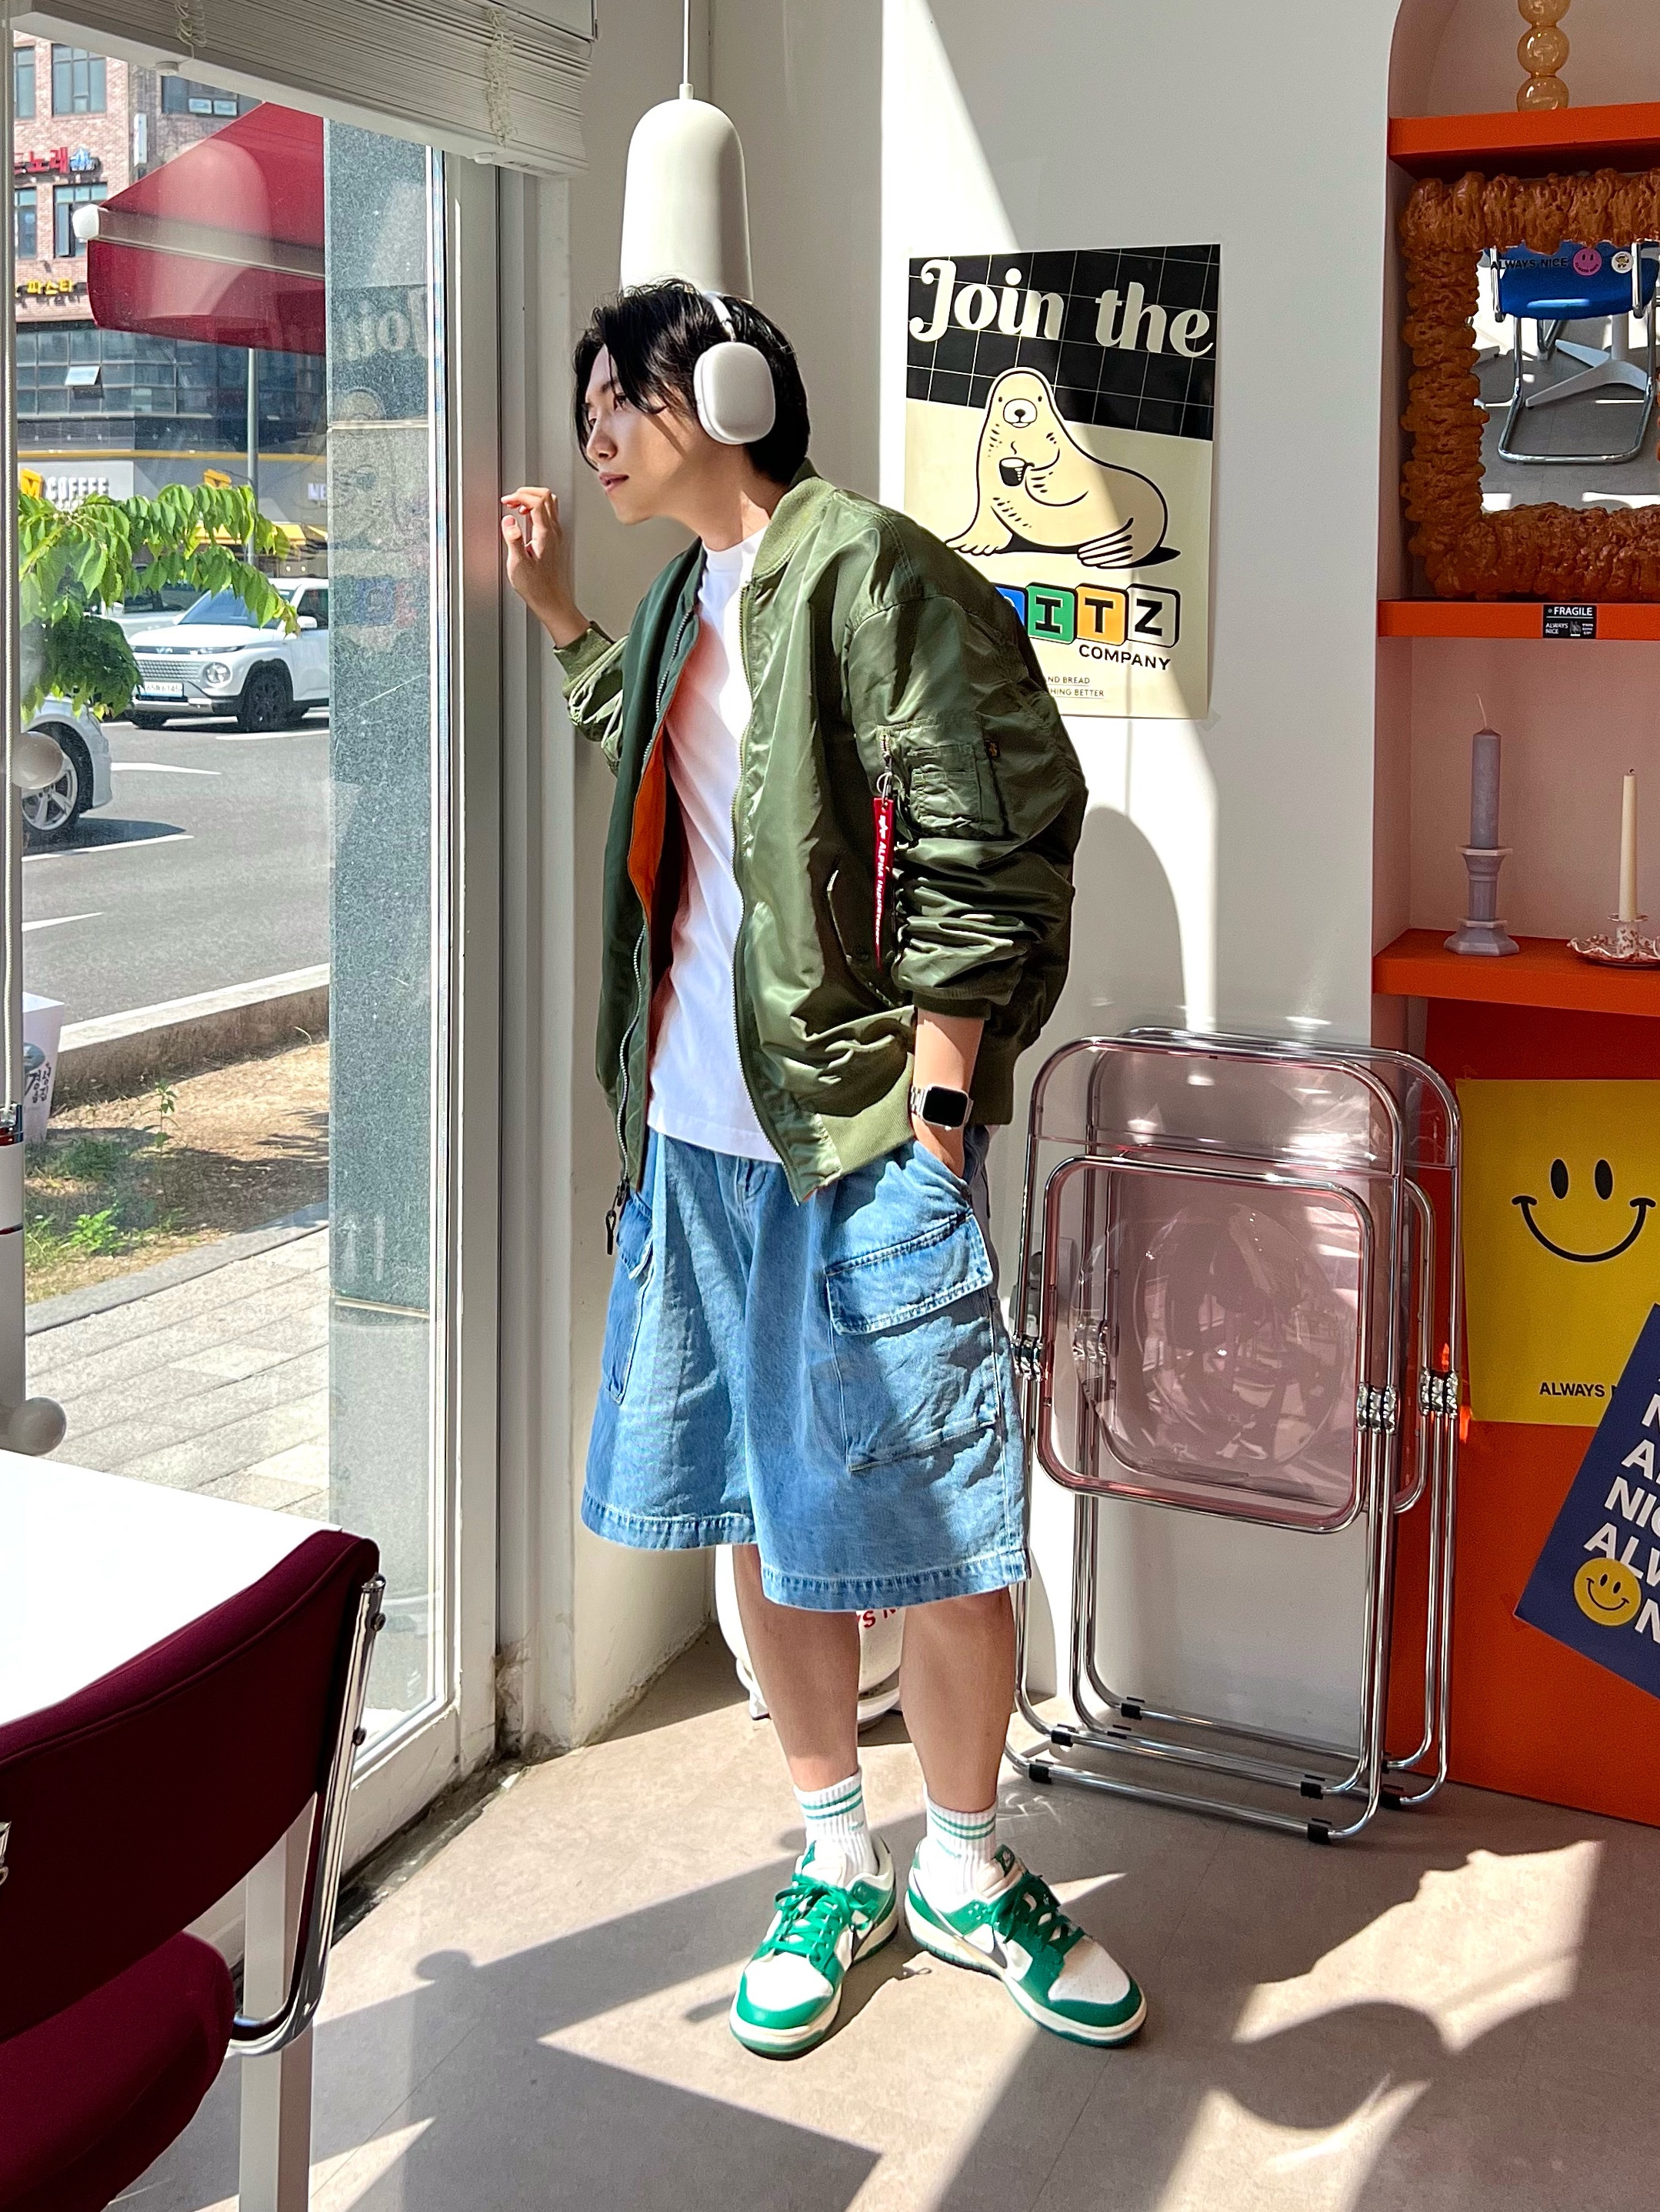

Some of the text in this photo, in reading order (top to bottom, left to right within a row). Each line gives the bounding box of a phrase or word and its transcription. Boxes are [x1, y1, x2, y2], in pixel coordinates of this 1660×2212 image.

[1540, 258, 1568, 268] NICE
[909, 259, 1214, 358] Join the
[1004, 596, 1164, 638] ITZ
[1553, 606, 1593, 616] FRAGILE
[1078, 644, 1172, 671] COMPANY
[877, 840, 887, 877] ALPHA
[1539, 1382, 1605, 1398] ALWAYS
